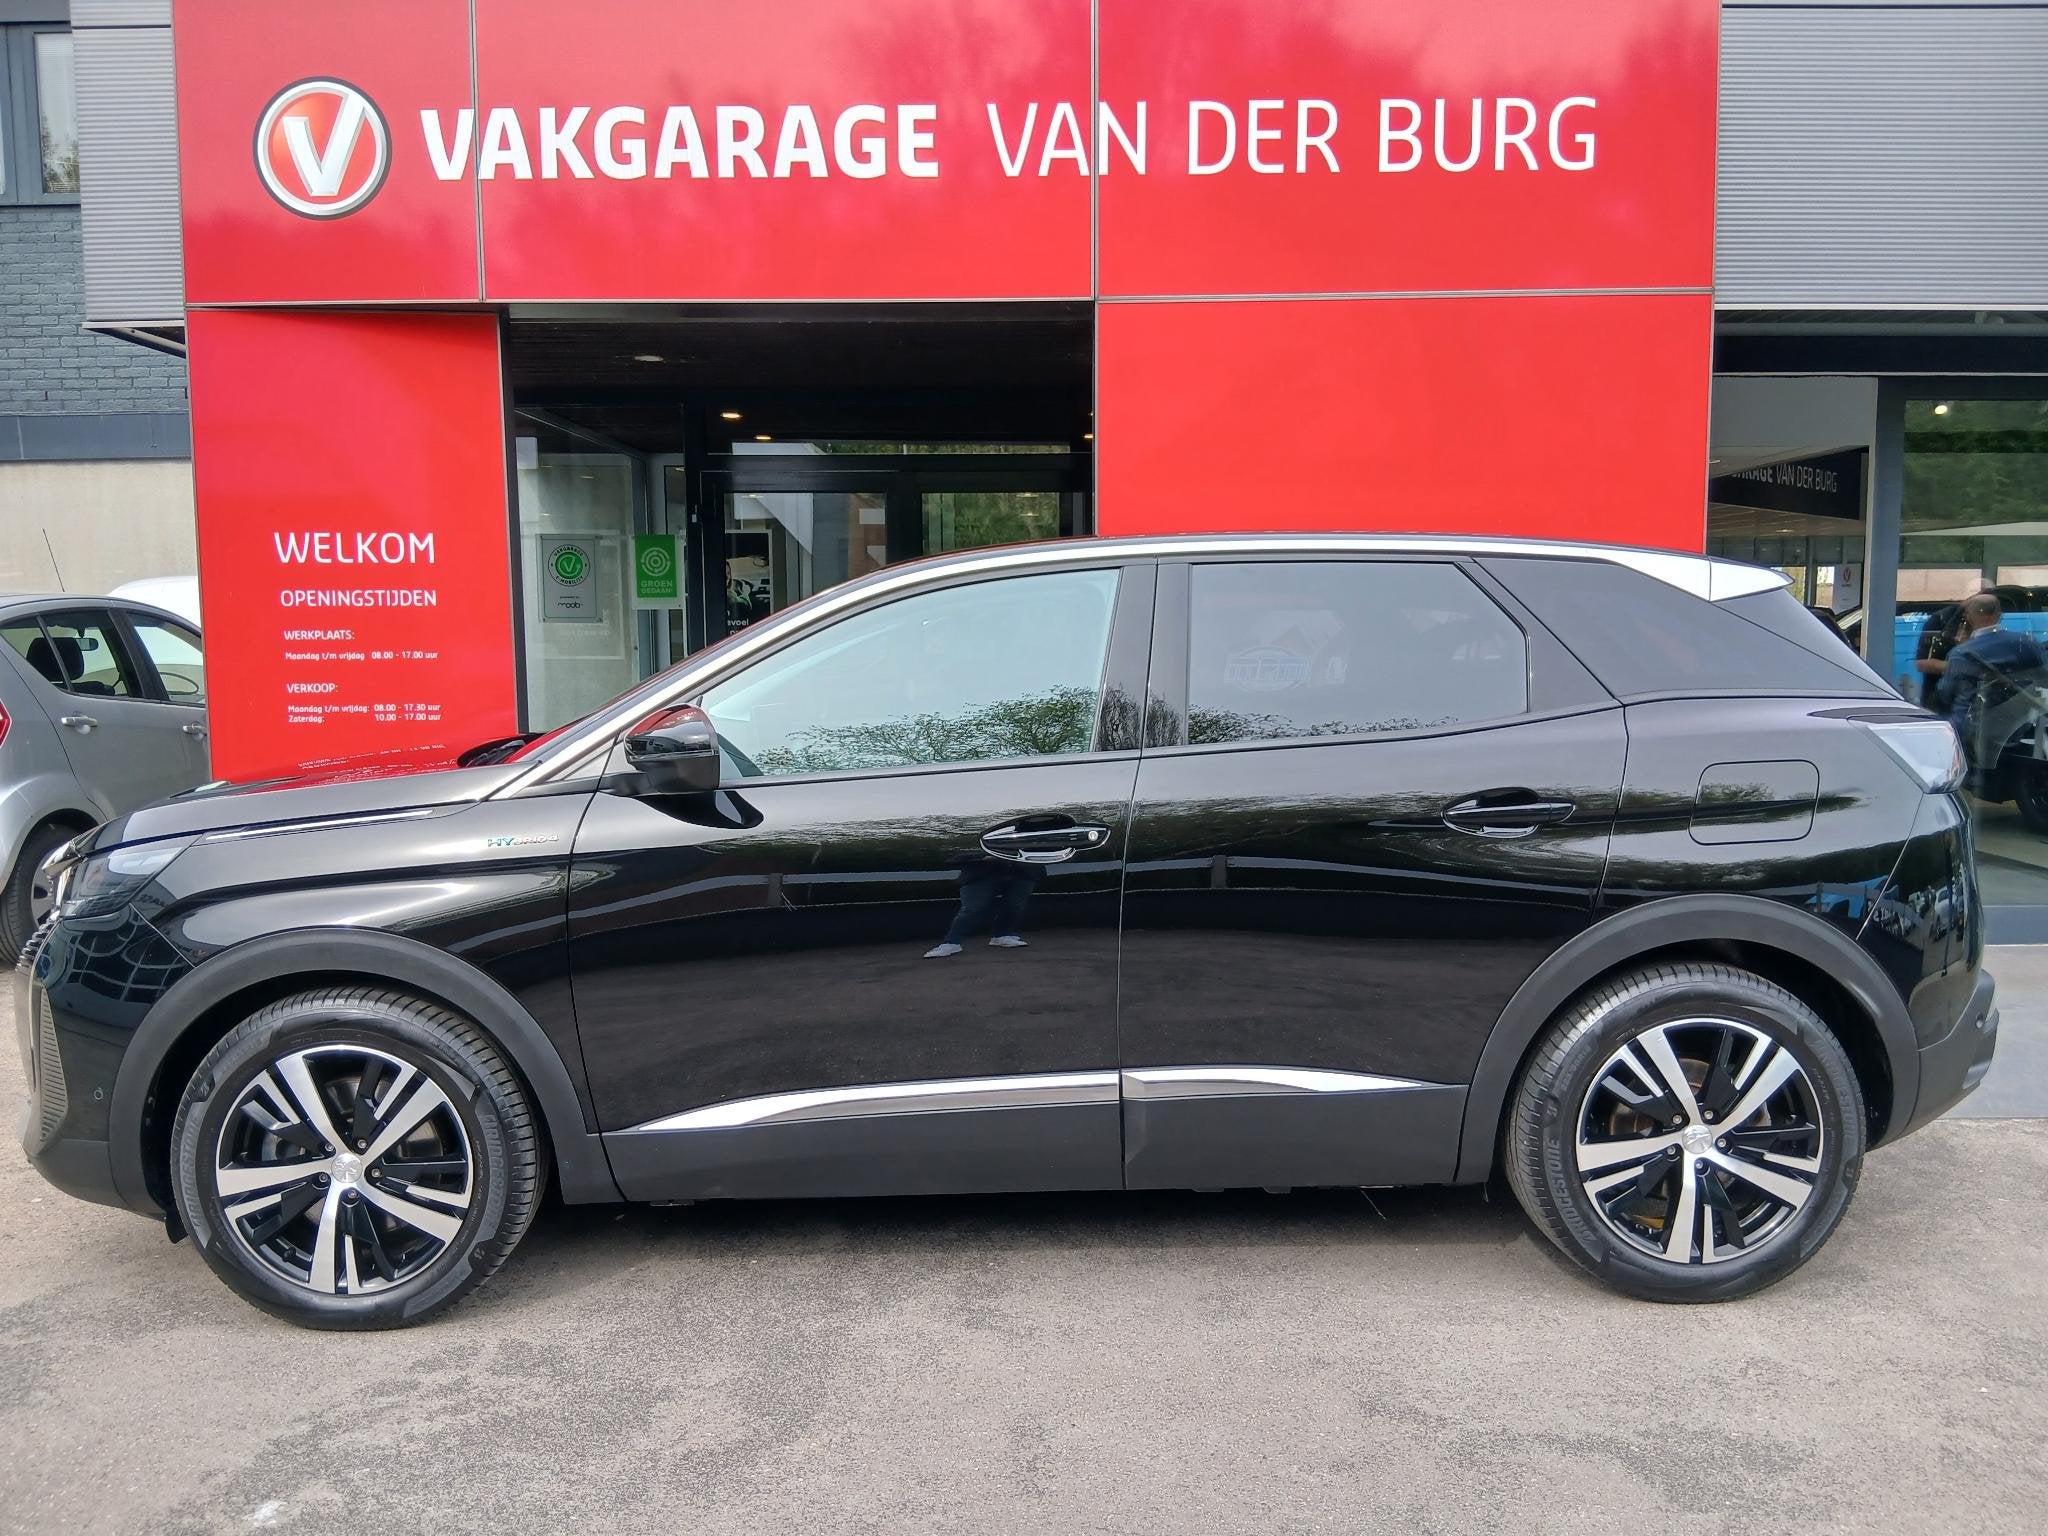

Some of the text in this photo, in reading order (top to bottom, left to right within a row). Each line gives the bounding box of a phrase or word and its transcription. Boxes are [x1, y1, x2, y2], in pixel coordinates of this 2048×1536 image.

[420, 97, 1597, 180] VAKGARAGE VAN DER BURG
[1776, 464, 1794, 486] VAN
[1797, 466, 1813, 489] DER
[1816, 469, 1838, 492] BURG
[274, 532, 435, 563] WELKOM
[640, 580, 673, 588] GROEN
[280, 590, 437, 607] OPENINGSTIJDEN
[283, 630, 355, 640] WERKPLAATS:
[285, 652, 320, 661] Maandag
[322, 651, 337, 660] t/m
[371, 651, 393, 659] 08.00
[402, 651, 423, 659] 17.00
[286, 683, 338, 694] VERKOOP:
[288, 705, 323, 714] Maandag
[325, 704, 339, 712] t/m
[342, 704, 370, 713] vrijdag:
[288, 715, 325, 724] Zaterdag:
[375, 714, 396, 722] 10.00
